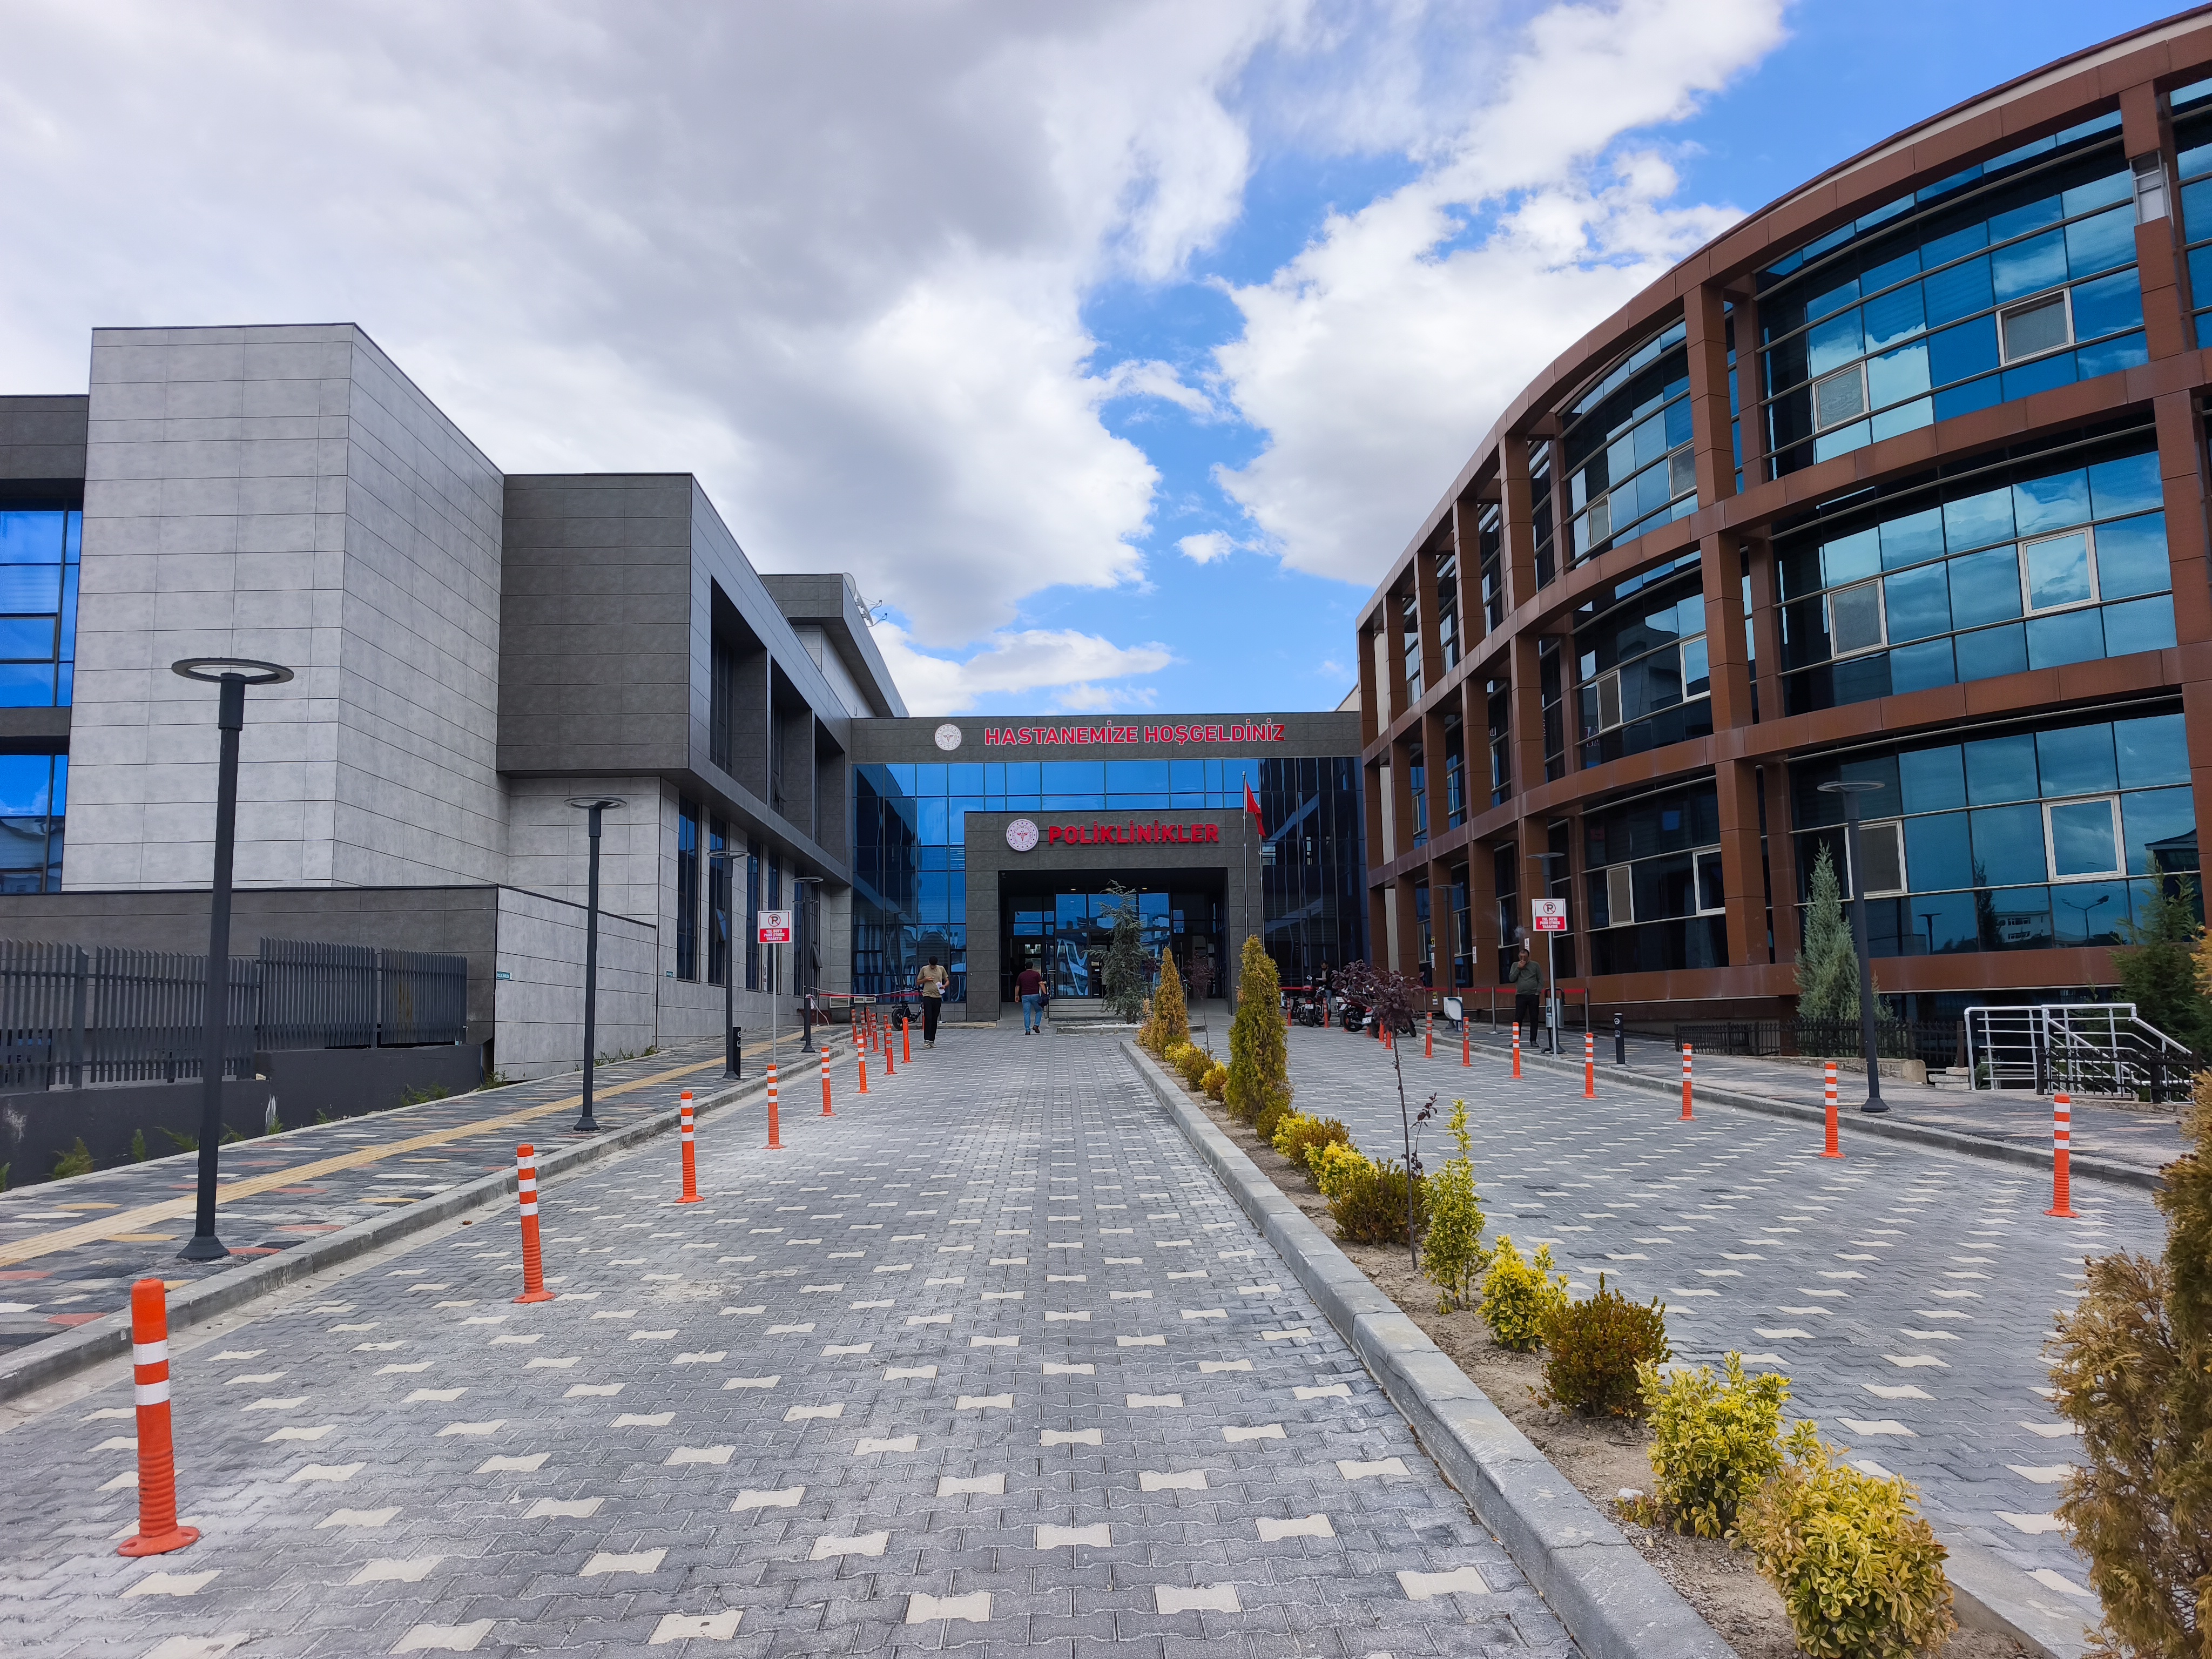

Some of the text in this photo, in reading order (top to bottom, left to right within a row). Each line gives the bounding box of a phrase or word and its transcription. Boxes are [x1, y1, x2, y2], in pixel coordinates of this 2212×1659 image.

[984, 720, 1138, 745] HASTANEMİZE
[1144, 718, 1285, 746] HOŞGELDİNİZ
[1048, 820, 1219, 845] POLİKLİNİKLER
